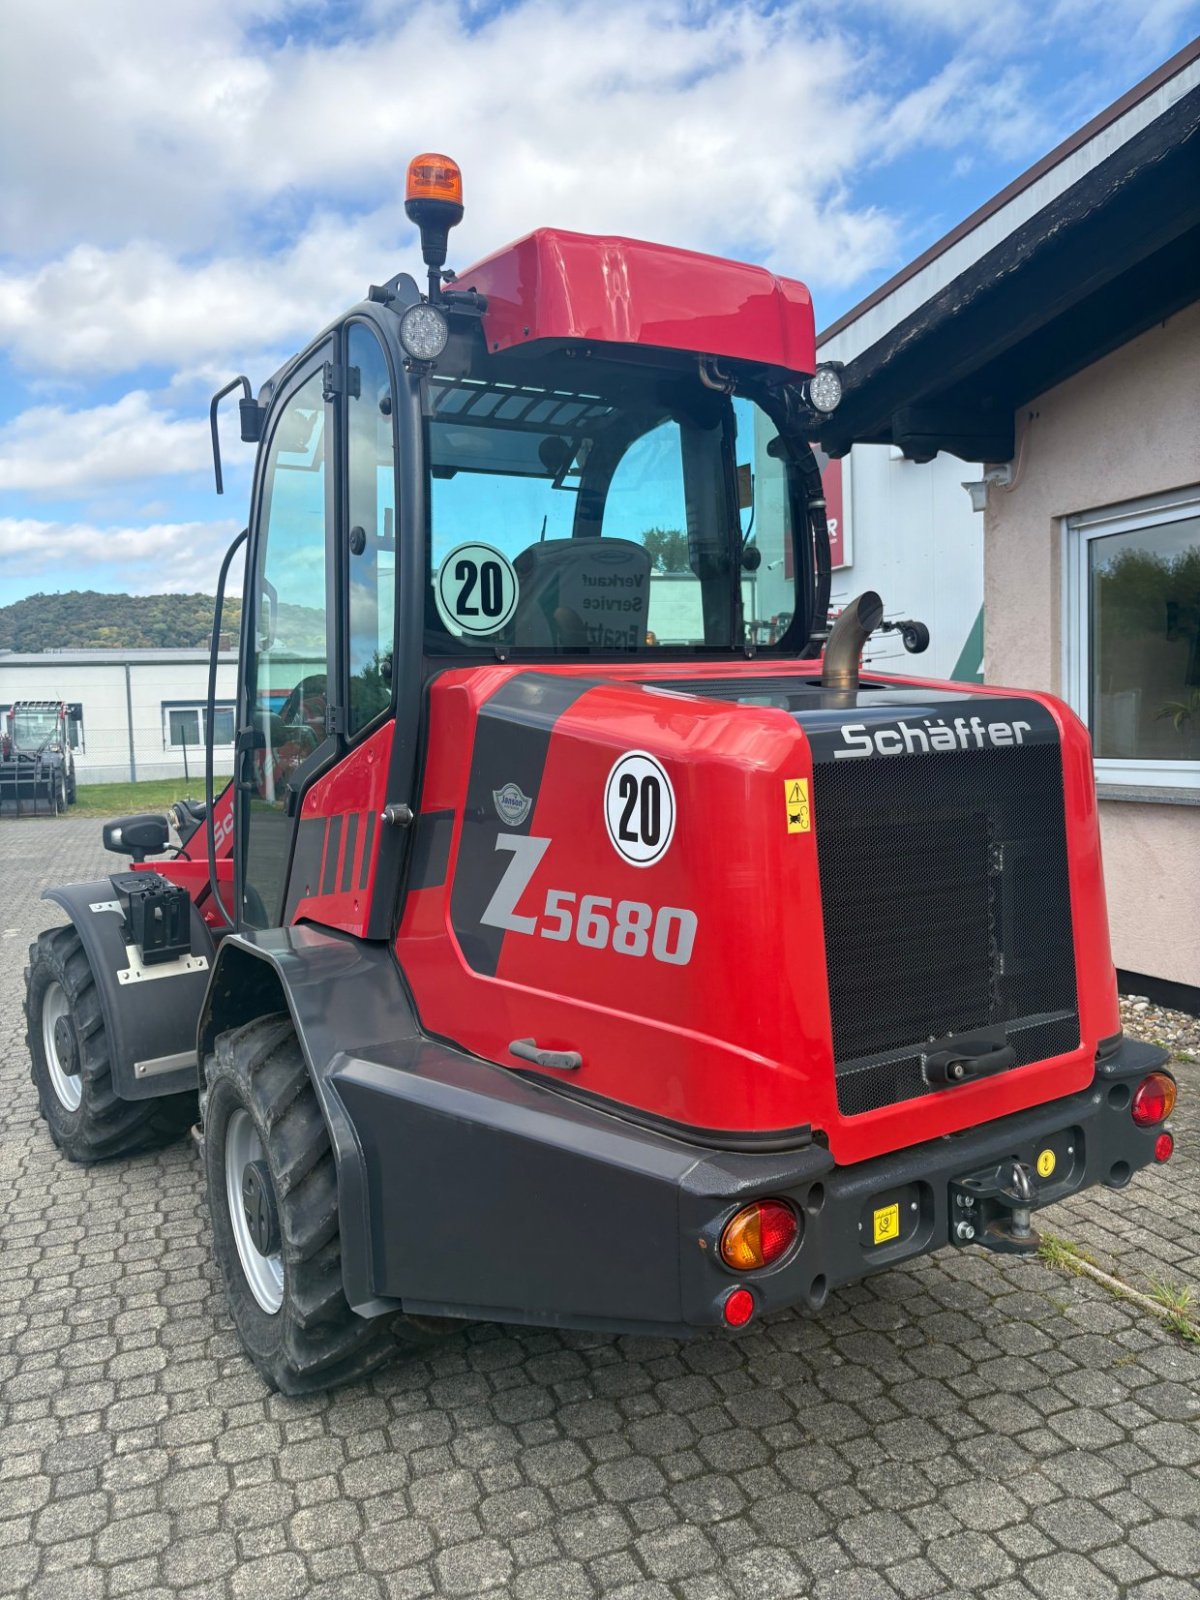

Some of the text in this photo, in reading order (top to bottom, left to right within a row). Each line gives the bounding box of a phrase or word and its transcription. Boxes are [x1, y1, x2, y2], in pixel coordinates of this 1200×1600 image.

[455, 560, 503, 617] 20
[833, 716, 1032, 759] Schäffer
[618, 773, 661, 847] 20
